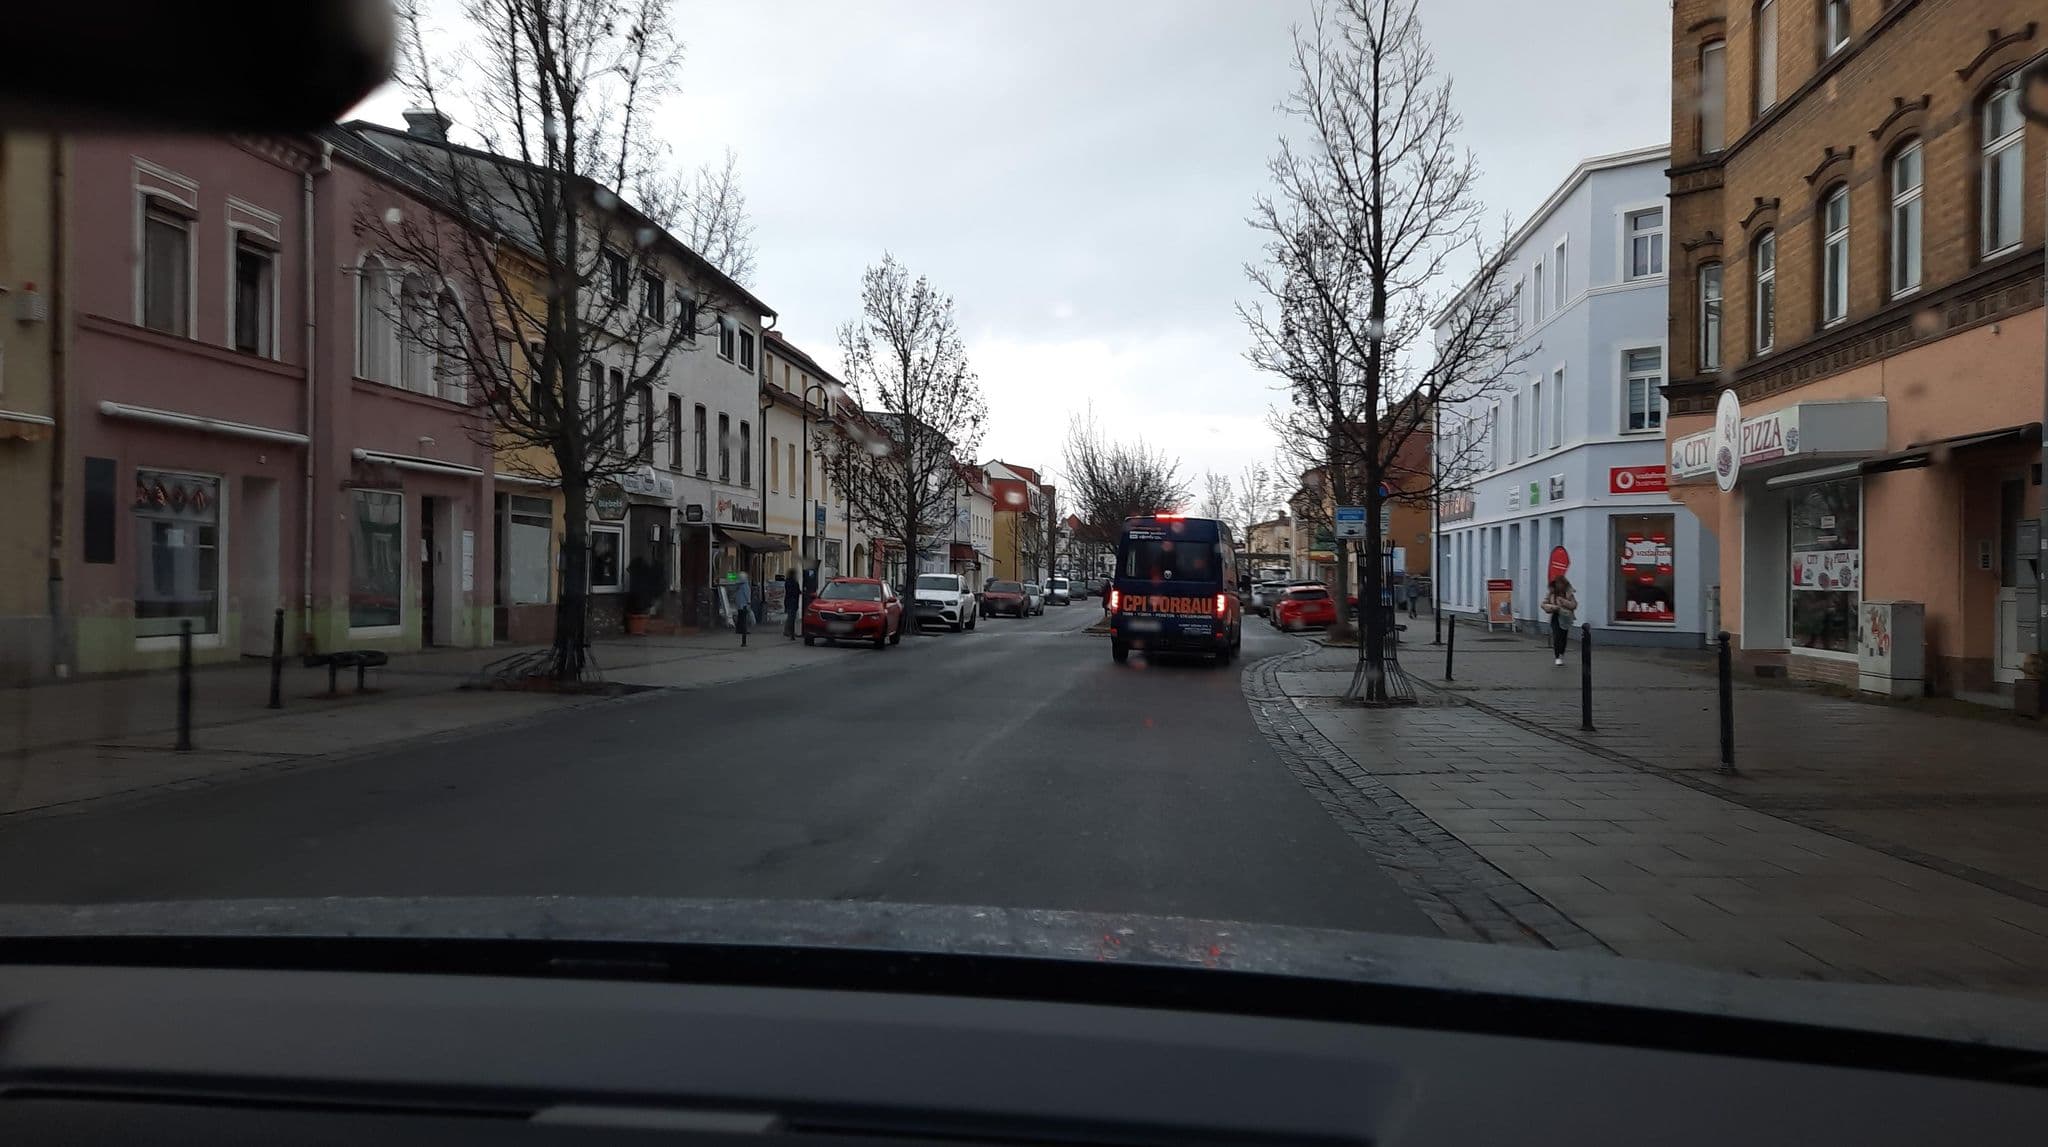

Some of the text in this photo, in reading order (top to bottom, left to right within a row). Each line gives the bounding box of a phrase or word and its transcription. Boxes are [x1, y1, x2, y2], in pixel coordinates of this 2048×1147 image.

[1684, 437, 1710, 468] CITY
[1743, 417, 1781, 455] PIZZA
[1123, 595, 1212, 614] CPI TORBAU
